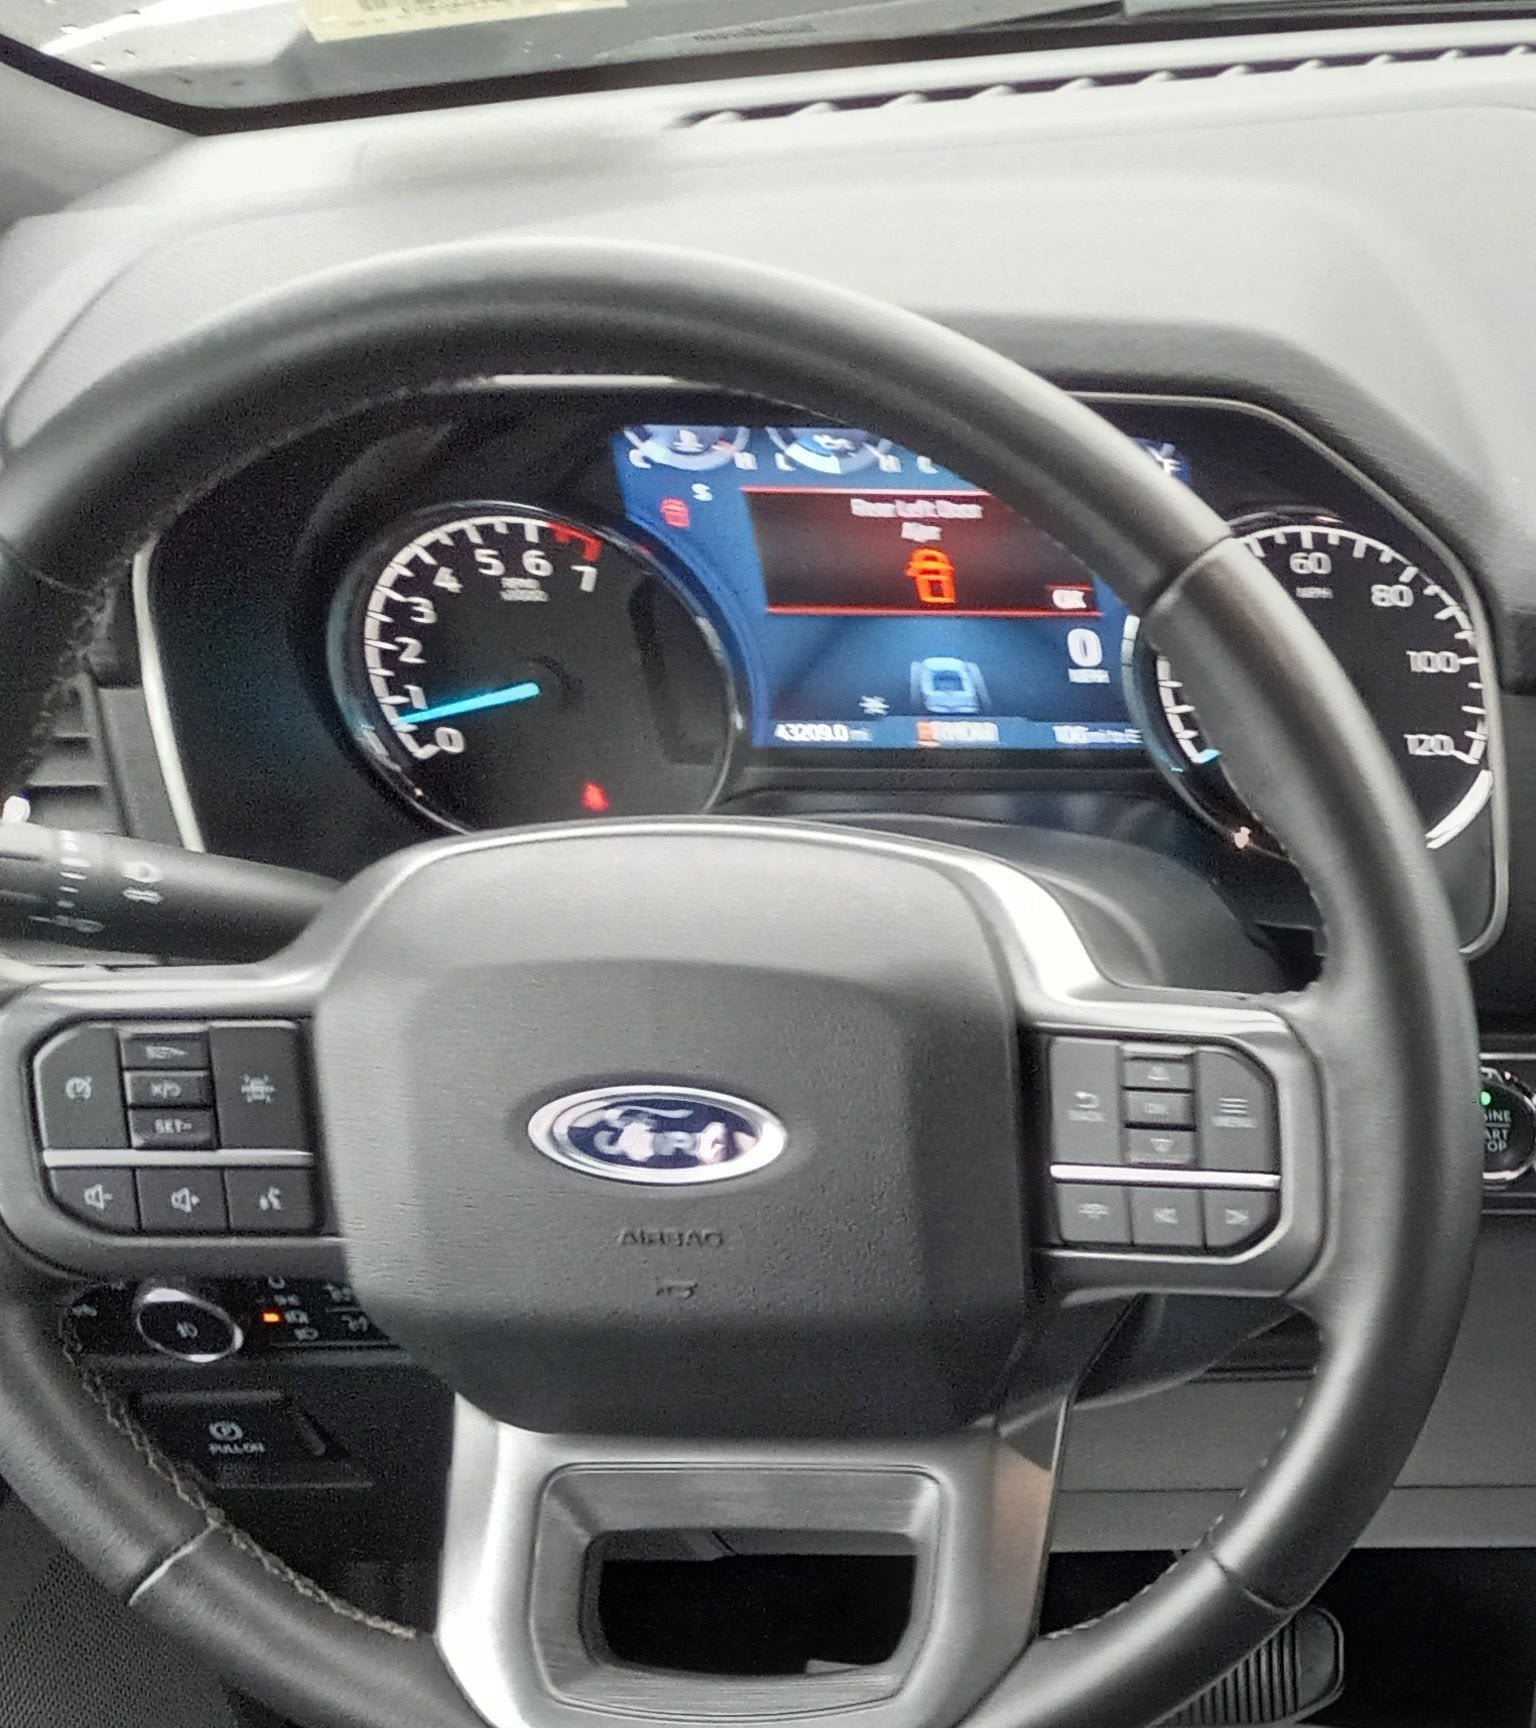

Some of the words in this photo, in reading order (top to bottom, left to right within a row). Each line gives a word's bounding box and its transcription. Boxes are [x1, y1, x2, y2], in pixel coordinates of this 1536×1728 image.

[474, 550, 505, 576] 5
[522, 550, 553, 576] 6
[1290, 552, 1332, 574] 60
[434, 567, 463, 593] 4
[571, 565, 597, 592] 7
[1370, 584, 1414, 607] 80
[408, 597, 437, 624] 3
[396, 637, 426, 664] 2
[1067, 628, 1102, 667] 0
[1406, 651, 1461, 673] 100
[404, 685, 427, 709] 1
[435, 727, 465, 753] 0
[1403, 733, 1455, 756] 120
